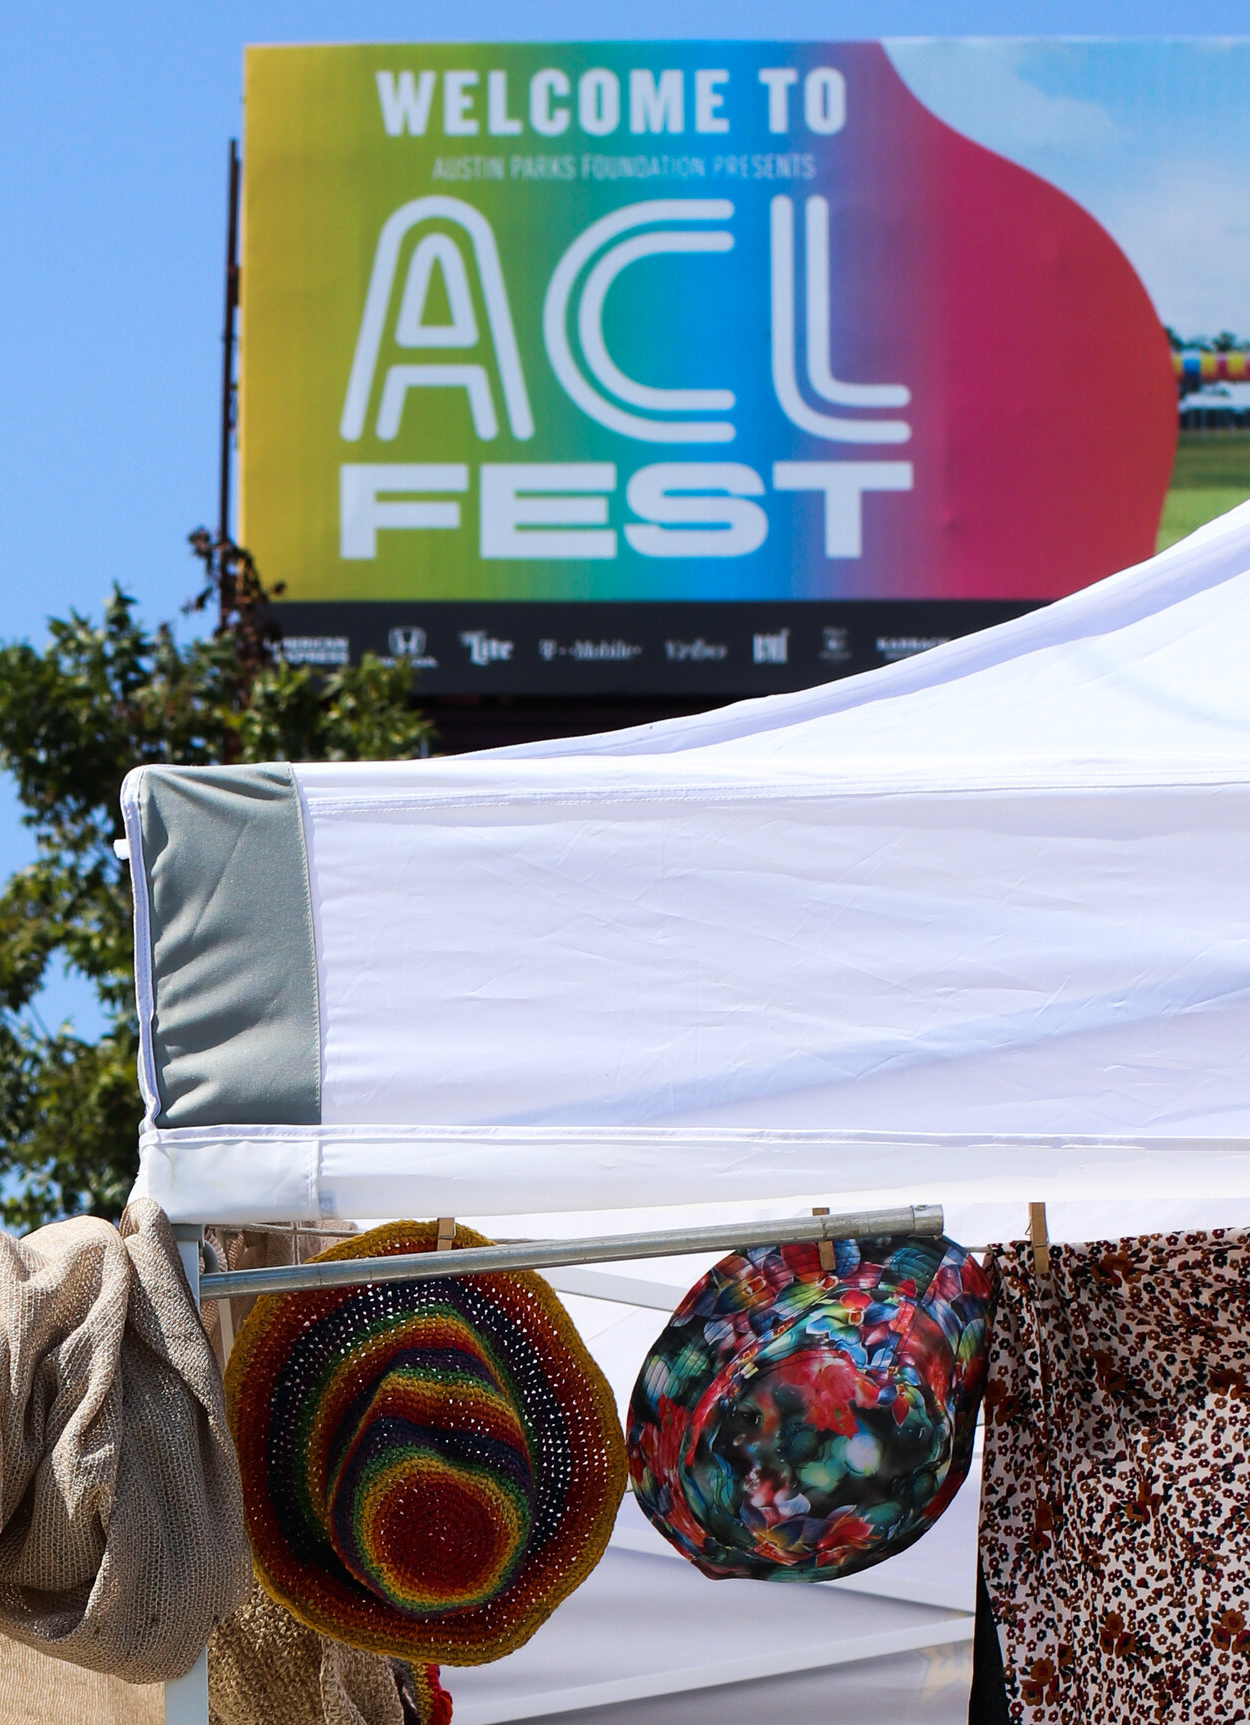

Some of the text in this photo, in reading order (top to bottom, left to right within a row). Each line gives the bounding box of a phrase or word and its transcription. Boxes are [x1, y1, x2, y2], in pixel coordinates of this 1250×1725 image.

[376, 67, 846, 136] WELCOME TO
[433, 153, 816, 181] AUSTIN PARKS FOUNDATION PRESENTS
[340, 195, 911, 443] ACL
[340, 462, 913, 559] FEST
[459, 629, 513, 665] Lite
